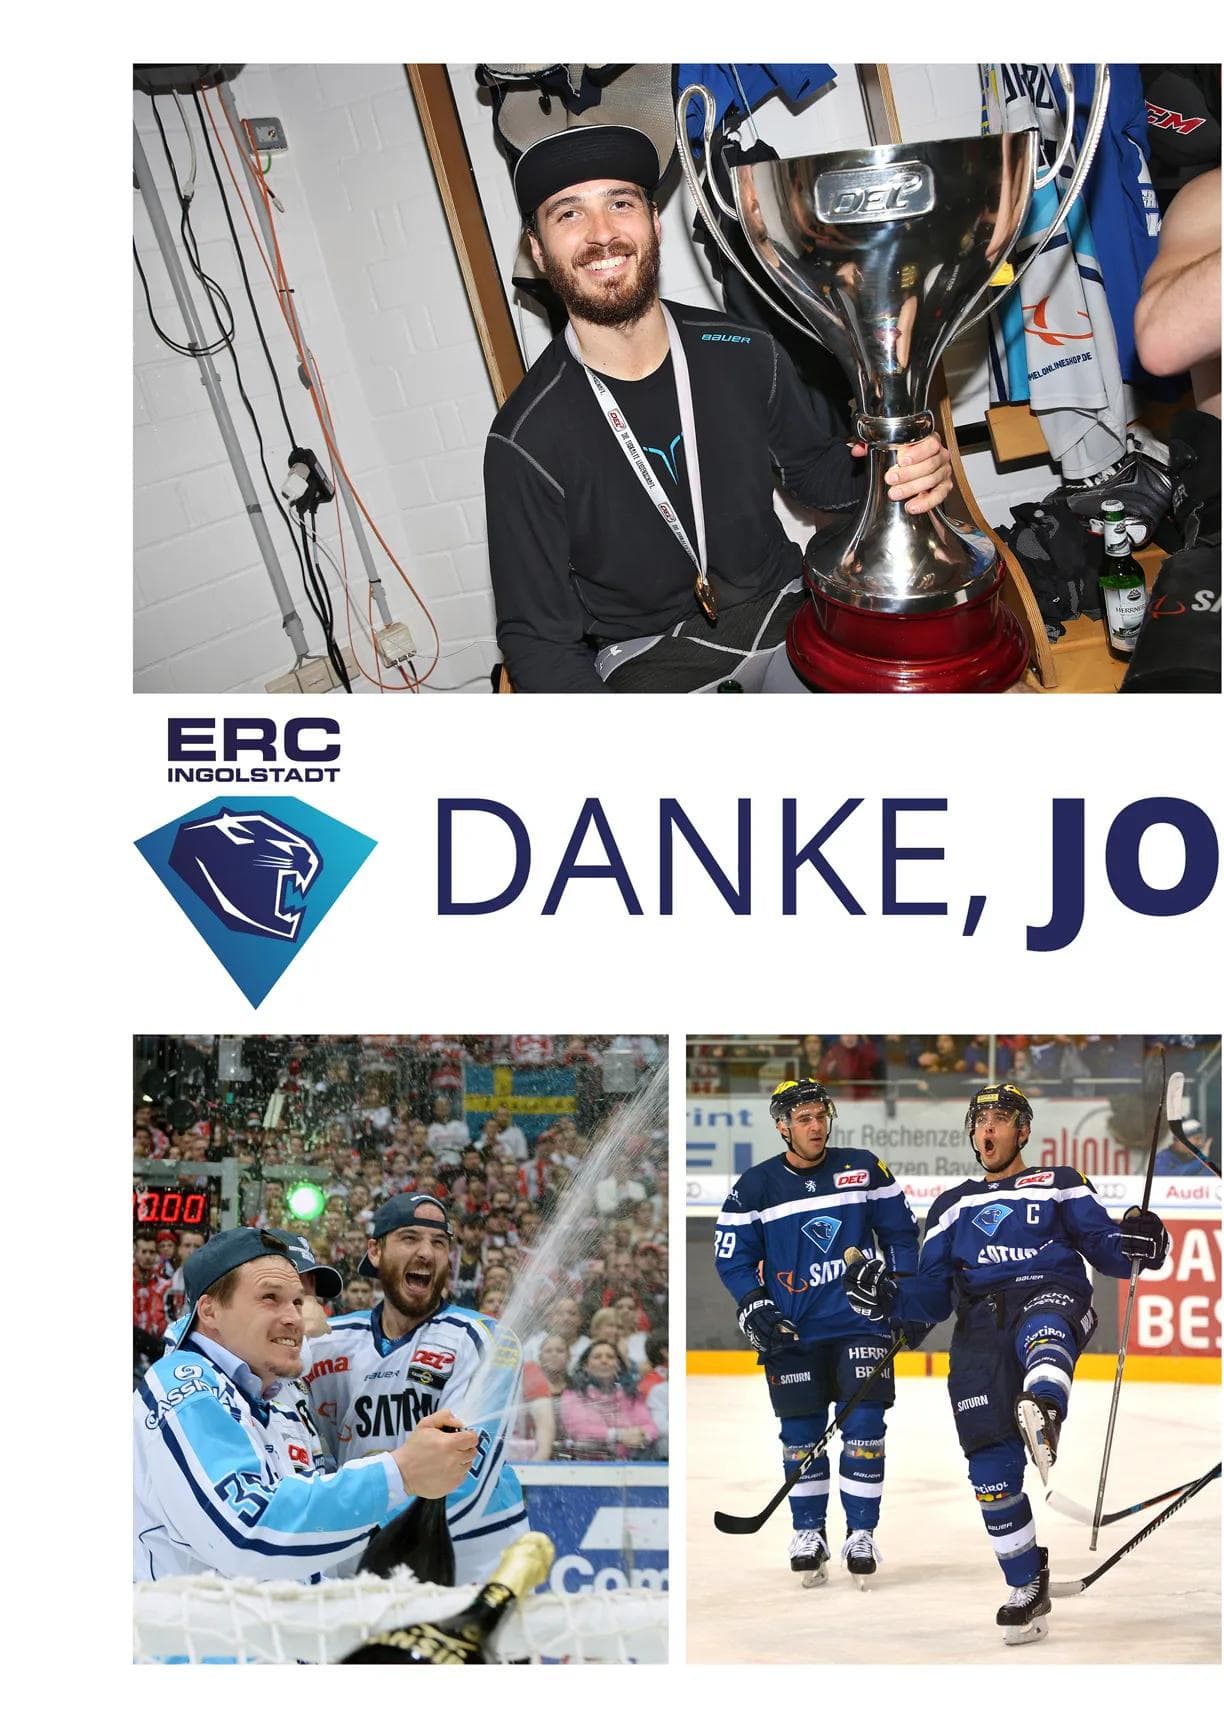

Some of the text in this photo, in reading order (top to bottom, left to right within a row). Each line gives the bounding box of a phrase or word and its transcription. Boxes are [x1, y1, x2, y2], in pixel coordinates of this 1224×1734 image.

[701, 332, 751, 344] BAUER
[837, 1171, 868, 1186] DEL
[1166, 1185, 1210, 1200] Audi
[1026, 1203, 1041, 1225] C
[780, 1371, 812, 1385] SATURN
[957, 1394, 989, 1412] SATURN
